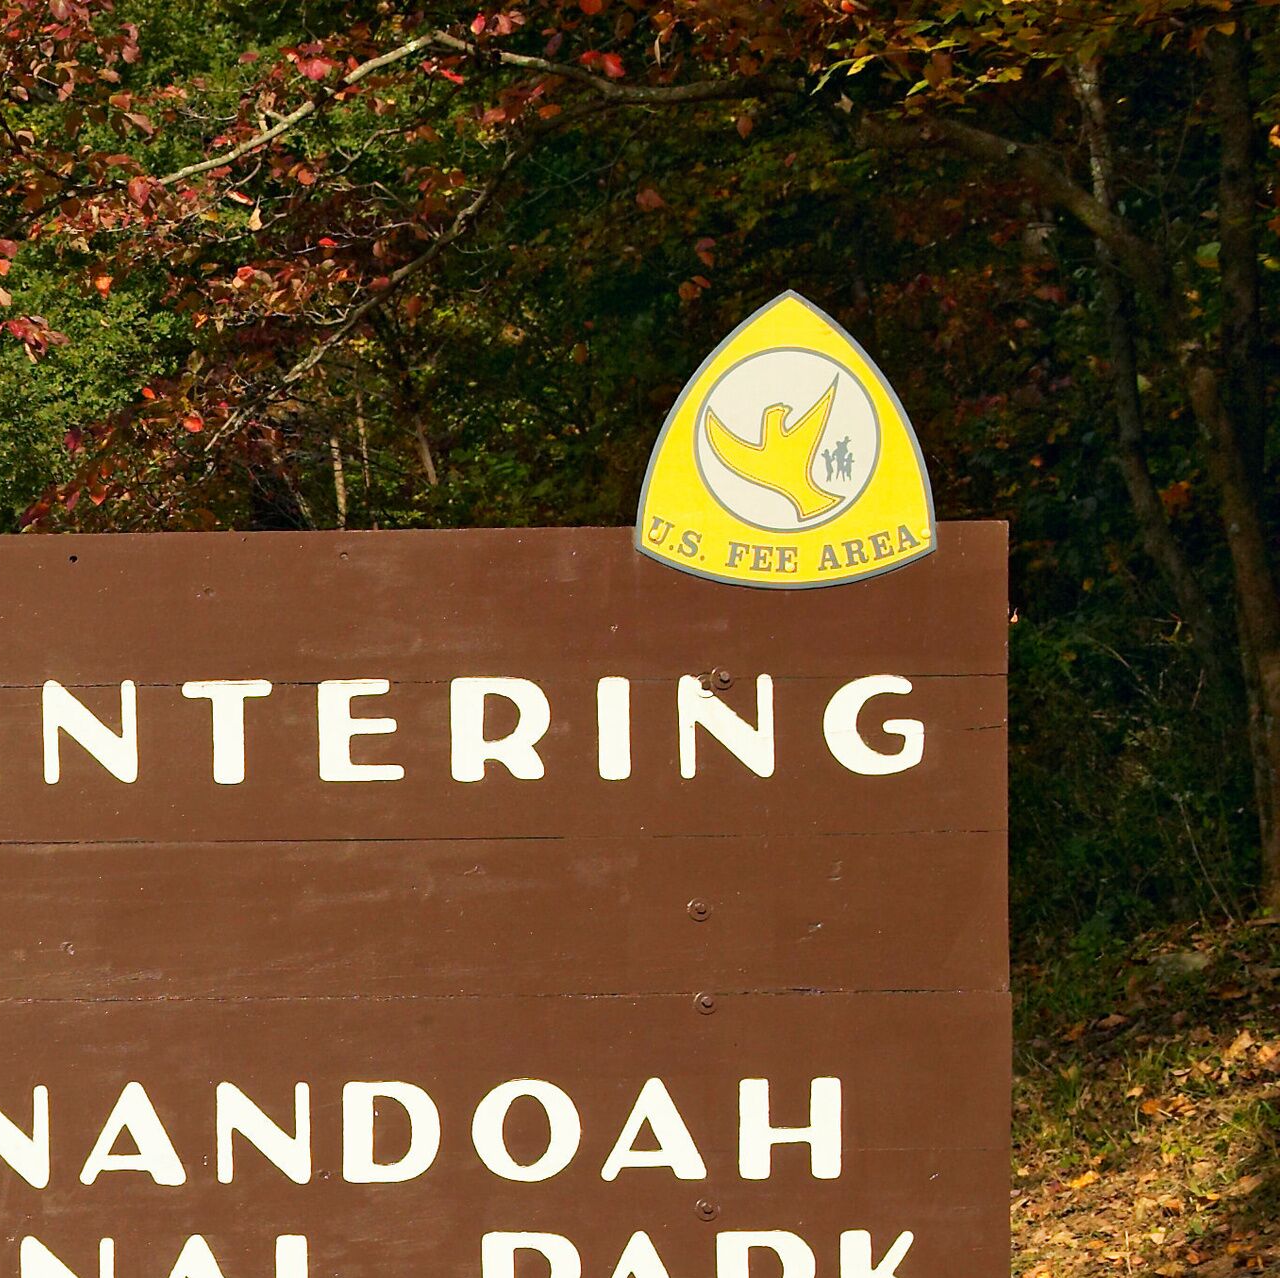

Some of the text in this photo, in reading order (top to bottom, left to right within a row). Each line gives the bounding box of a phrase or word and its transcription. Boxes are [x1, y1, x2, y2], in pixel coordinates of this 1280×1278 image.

[648, 516, 921, 573] U.S. FEE AREA
